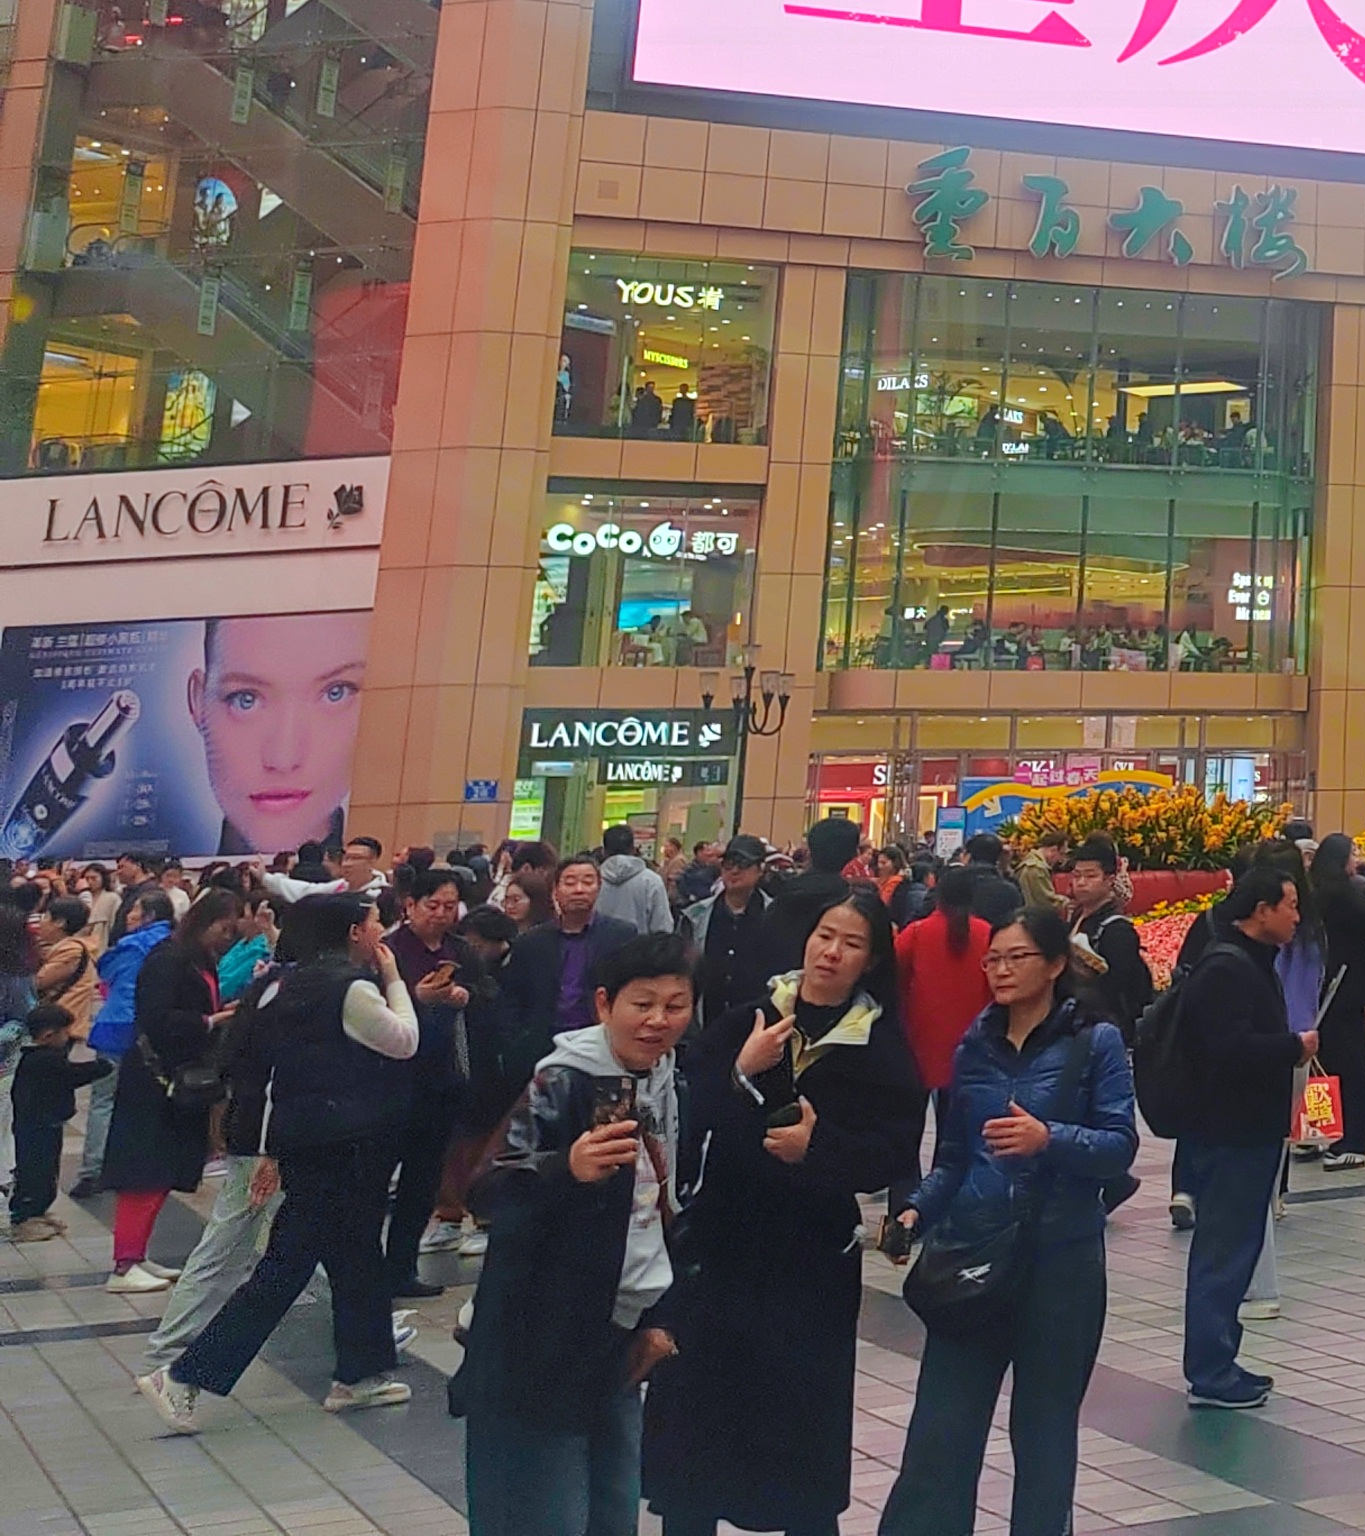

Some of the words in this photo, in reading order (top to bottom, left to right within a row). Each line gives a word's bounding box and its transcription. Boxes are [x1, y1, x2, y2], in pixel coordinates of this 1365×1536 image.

[617, 278, 694, 308] YOUS
[43, 478, 310, 542] LANCÔME
[690, 531, 739, 555] 都可
[530, 717, 690, 748] LANCÔME
[606, 761, 670, 782] LANCÔME
